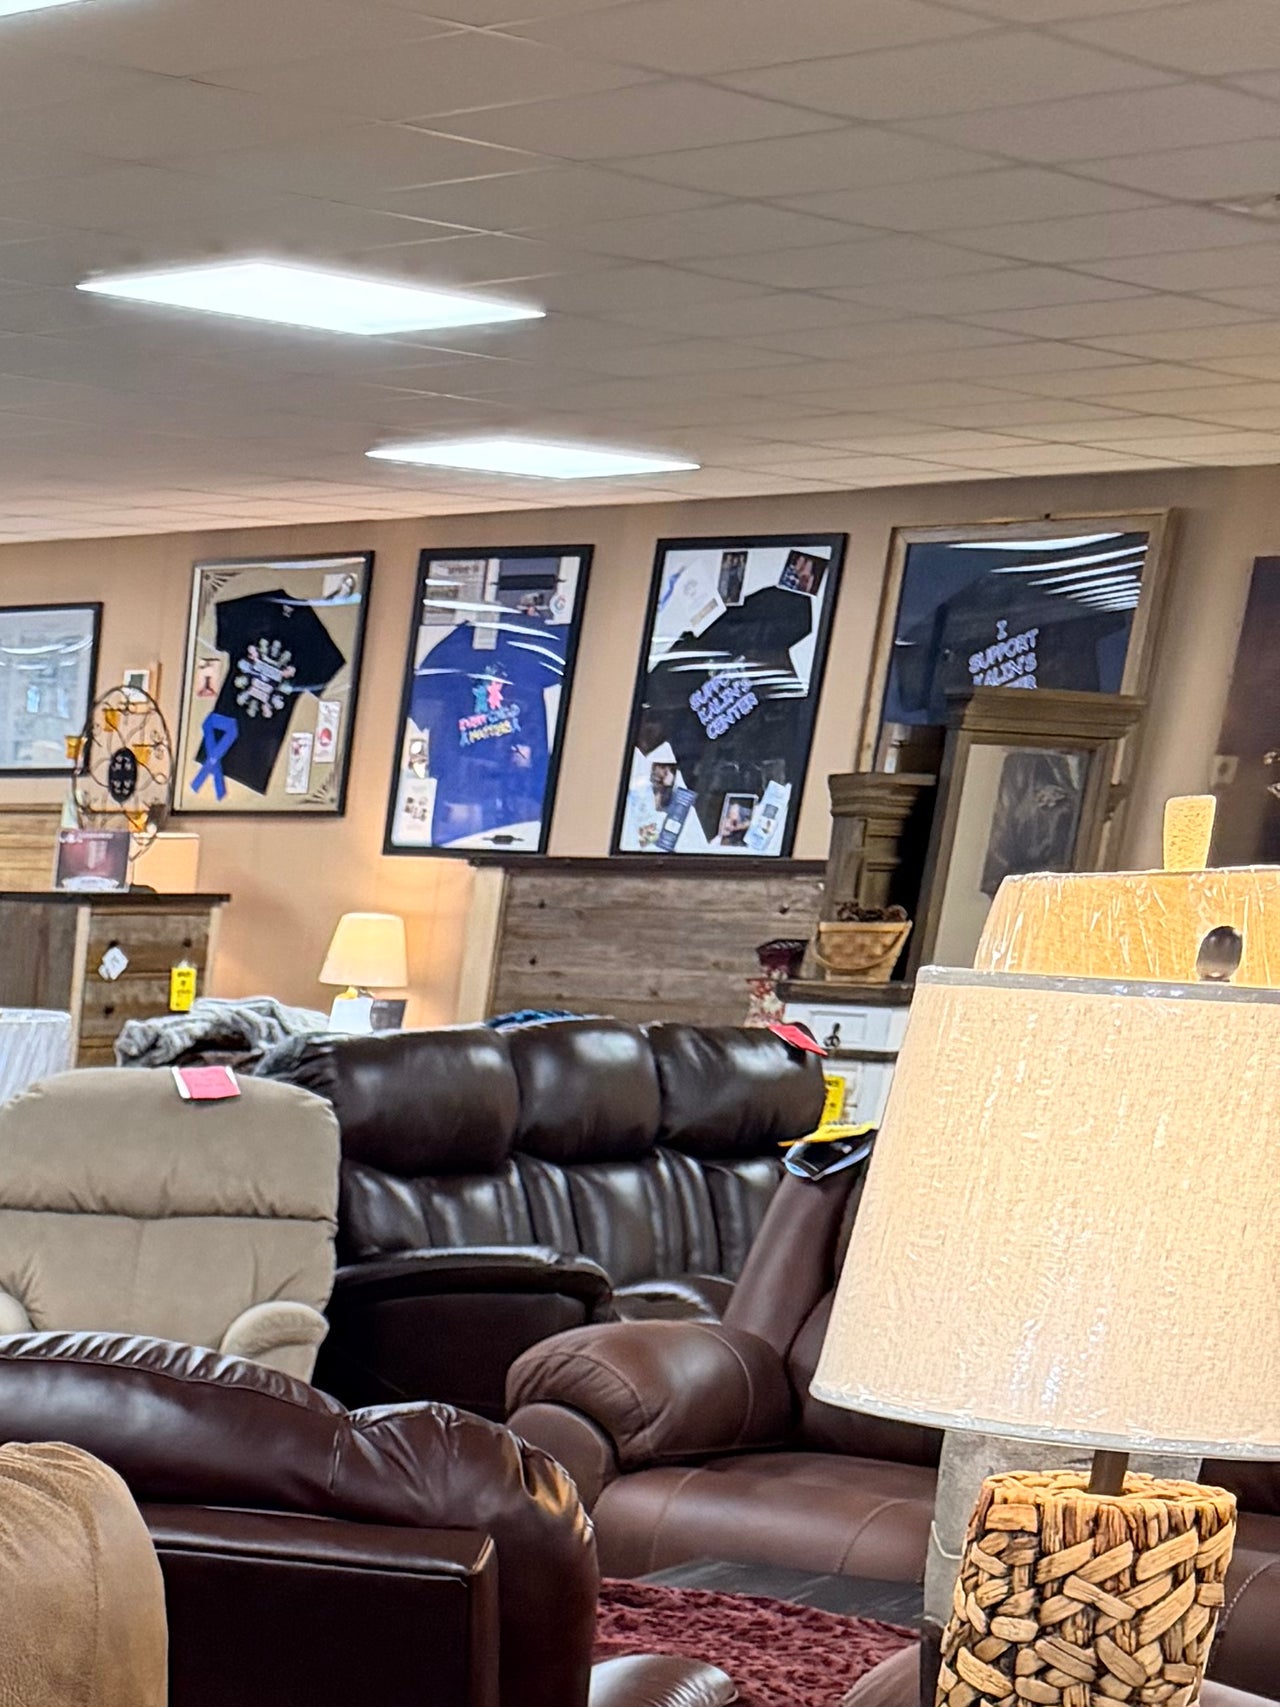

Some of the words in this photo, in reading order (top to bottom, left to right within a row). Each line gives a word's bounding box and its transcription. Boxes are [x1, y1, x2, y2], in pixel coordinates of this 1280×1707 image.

[968, 627, 1039, 674] SUPPORT
[996, 619, 1008, 641] I
[706, 691, 759, 740] CENTER
